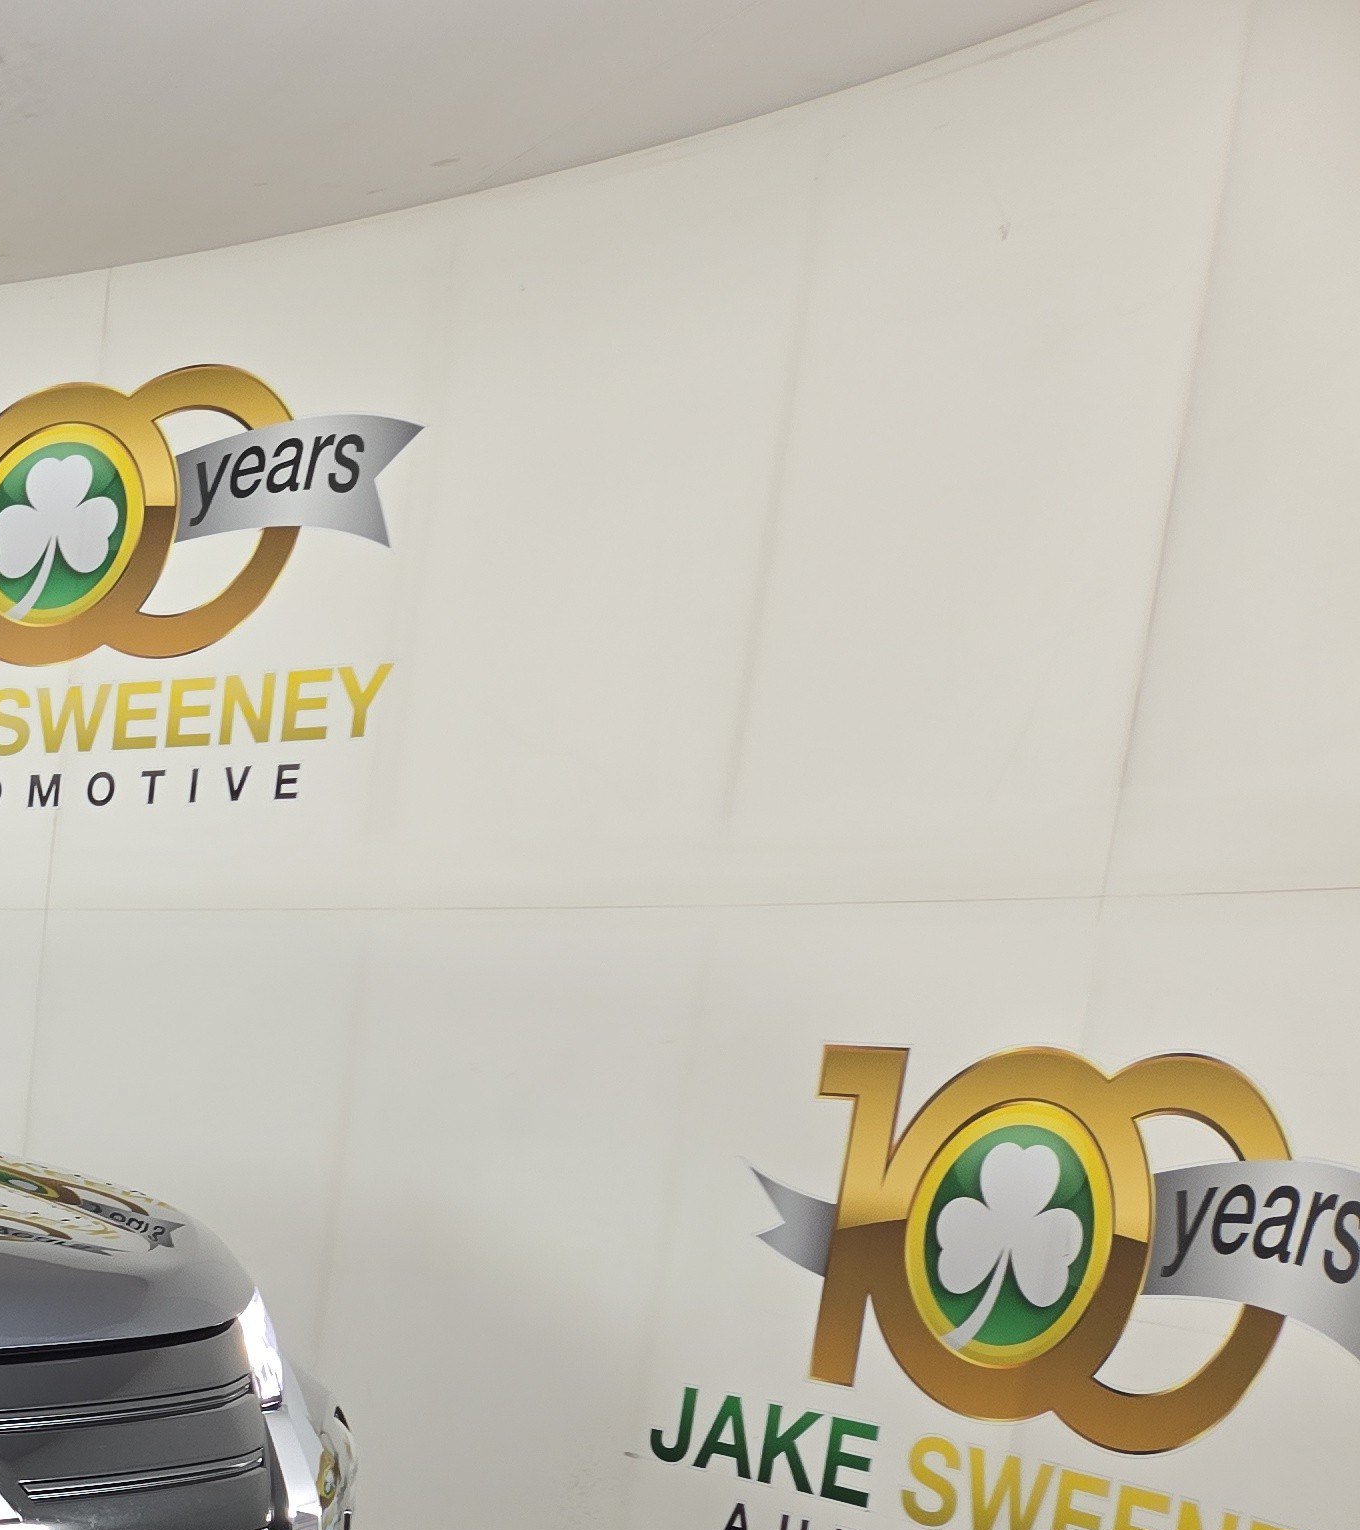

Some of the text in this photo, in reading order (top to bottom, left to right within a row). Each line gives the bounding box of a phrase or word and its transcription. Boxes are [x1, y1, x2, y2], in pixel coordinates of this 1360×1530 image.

[190, 433, 366, 526] years
[808, 1044, 1292, 1455] 100
[1160, 1183, 1360, 1285] years
[650, 1386, 880, 1508] JAKE
